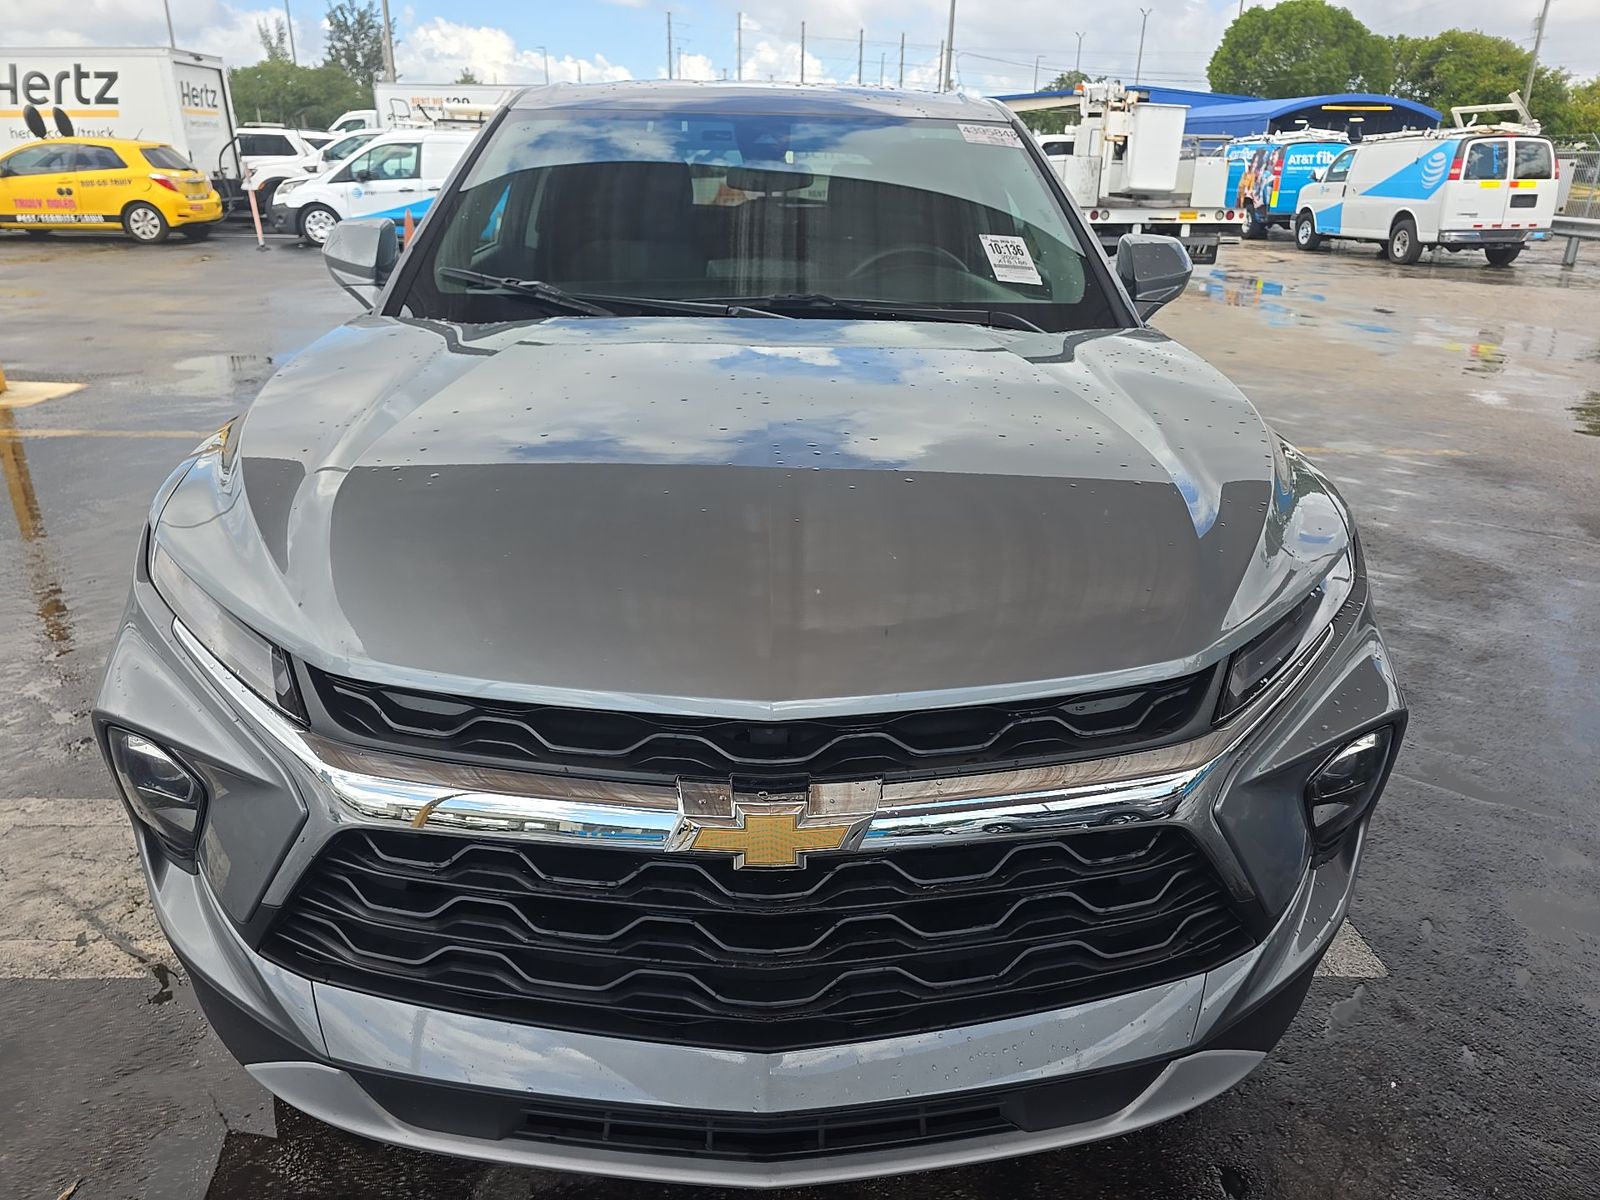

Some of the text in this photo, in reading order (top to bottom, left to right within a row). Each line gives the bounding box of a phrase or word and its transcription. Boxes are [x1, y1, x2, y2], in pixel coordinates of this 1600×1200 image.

[0, 63, 119, 105] Hertz
[180, 80, 218, 108] Hertz
[9, 126, 115, 139] herco/truck
[1287, 150, 1336, 165] AT&T fib
[988, 242, 1025, 257] 10:136
